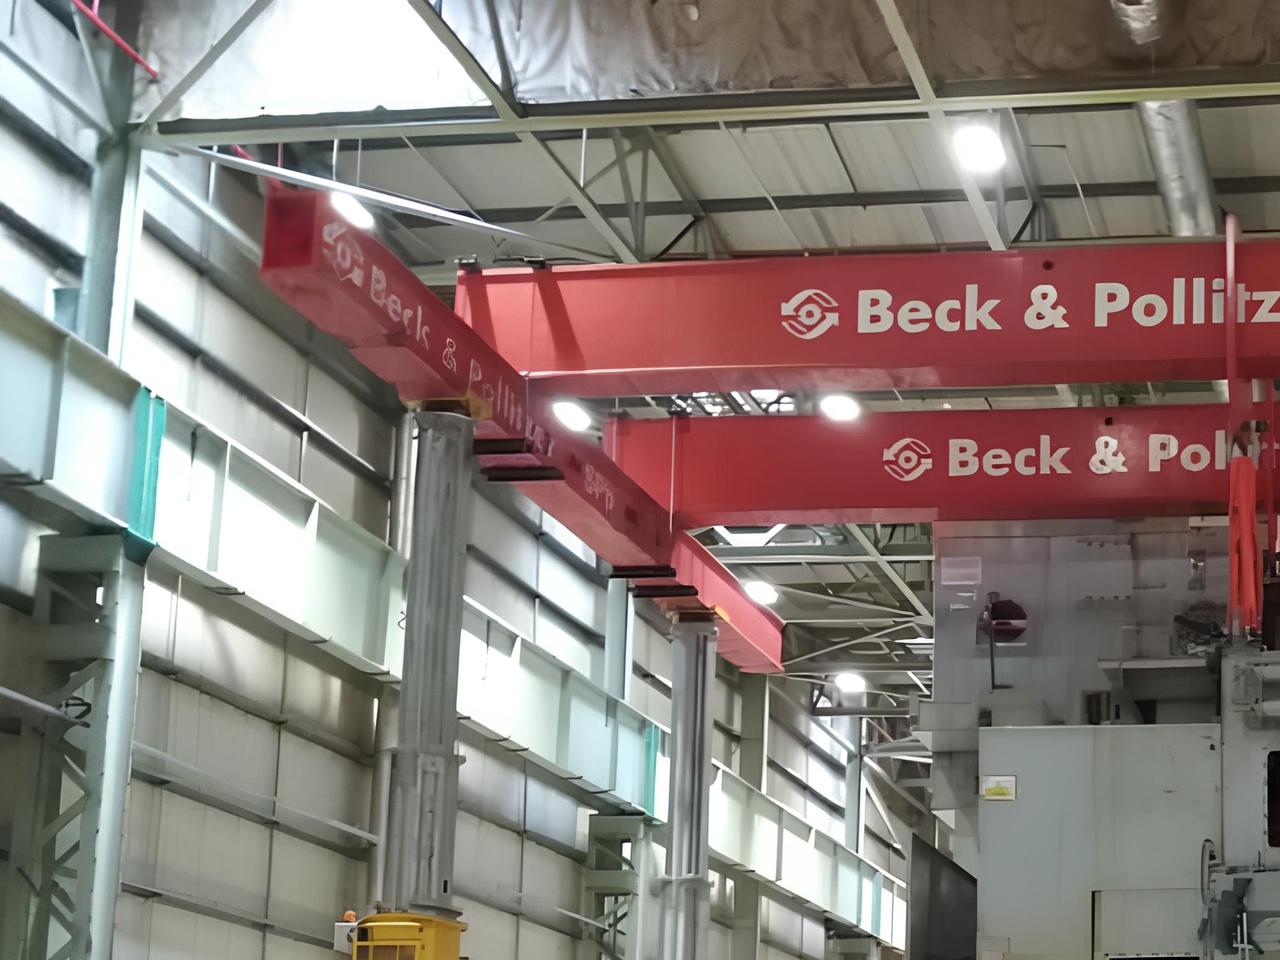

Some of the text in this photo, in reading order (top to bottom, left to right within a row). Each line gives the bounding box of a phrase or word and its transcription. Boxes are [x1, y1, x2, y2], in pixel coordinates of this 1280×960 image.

[857, 284, 1002, 333] Beck
[1023, 284, 1069, 330] &
[948, 434, 1072, 476] Beck
[1088, 435, 1129, 475] &
